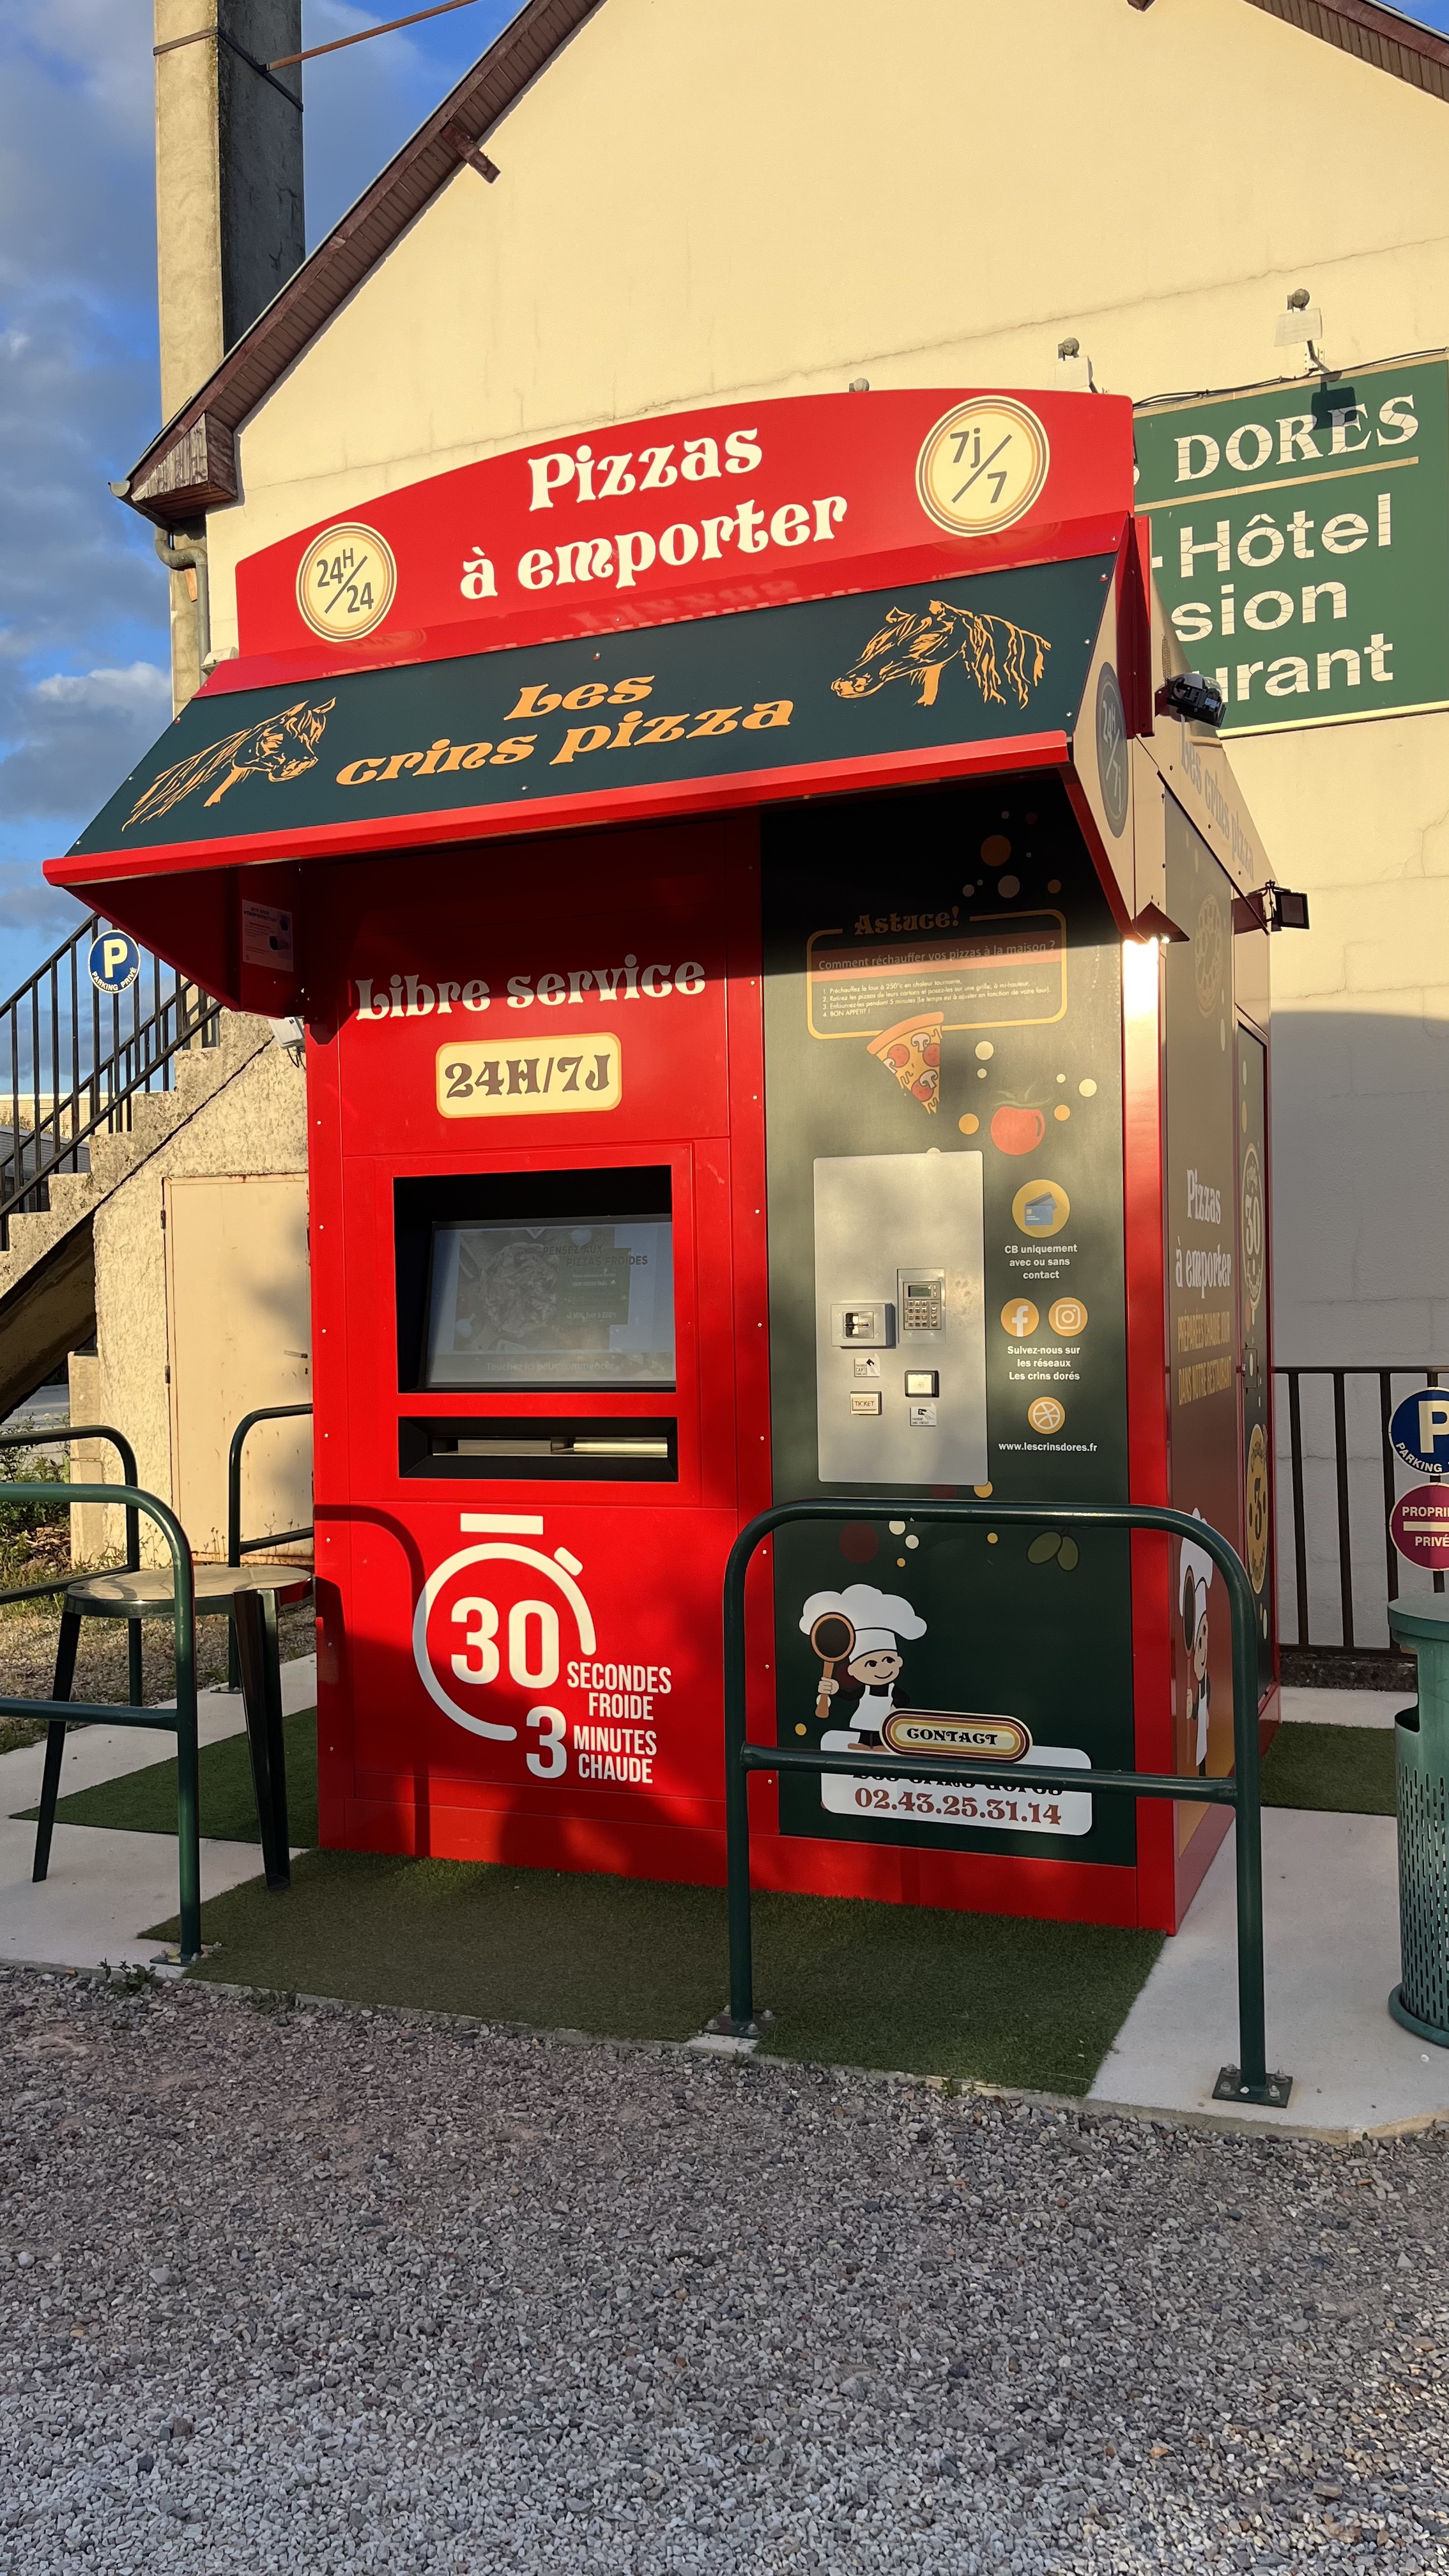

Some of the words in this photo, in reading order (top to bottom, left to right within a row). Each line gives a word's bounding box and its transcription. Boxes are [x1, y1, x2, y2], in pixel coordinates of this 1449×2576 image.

[1174, 394, 1420, 483] DORES
[528, 427, 763, 512] Pizzas
[459, 546, 499, 600] à
[517, 495, 848, 590] emporter
[503, 675, 656, 721] Les
[336, 733, 539, 786] crins
[549, 699, 795, 765] pizza
[103, 939, 128, 978] P
[818, 957, 868, 970] Comment
[872, 952, 926, 965] réchauffer
[928, 951, 946, 961] vos
[949, 947, 981, 962] pizzas
[983, 946, 990, 956] à
[993, 944, 1003, 955] la
[1006, 943, 1046, 954] maison
[91, 971, 118, 991] PARKING
[355, 974, 491, 1021] Libre
[506, 954, 706, 1009] service
[445, 1053, 611, 1099] 24H/7J
[1186, 1168, 1221, 1224] Pizzas
[1245, 1194, 1261, 1255] 30
[543, 1246, 579, 1255] PENSEZ
[583, 1245, 604, 1254] AUX
[566, 1257, 602, 1267] PIZZAS
[606, 1255, 648, 1266] FROIDES
[1004, 1245, 1019, 1254] CB
[1021, 1243, 1078, 1255] uniquement
[1047, 1258, 1071, 1266] sans
[1023, 1270, 1060, 1279] contact
[1176, 1235, 1183, 1287] à
[1186, 1243, 1232, 1300] emporter
[1007, 1346, 1063, 1354] Suivez-nous
[1017, 1359, 1031, 1367] les
[1033, 1358, 1071, 1367] réseaux
[1009, 1372, 1025, 1380] Les
[1027, 1371, 1052, 1380] crins
[1054, 1370, 1080, 1380] dorés
[1418, 1400, 1449, 1453] P
[999, 1442, 1098, 1452] www.lescrinsdores.fr
[1395, 1442, 1443, 1473] PARKING
[450, 1597, 560, 1689] 30
[567, 1661, 672, 1694] SECONDES
[588, 1692, 654, 1721] FROIDE
[526, 1705, 567, 1779] 3
[573, 1724, 657, 1756] MINUTES
[906, 1728, 998, 1746] CONTACT
[578, 1753, 653, 1784] CHAUDE
[854, 1788, 1062, 1825] 02.43.25.31.14
